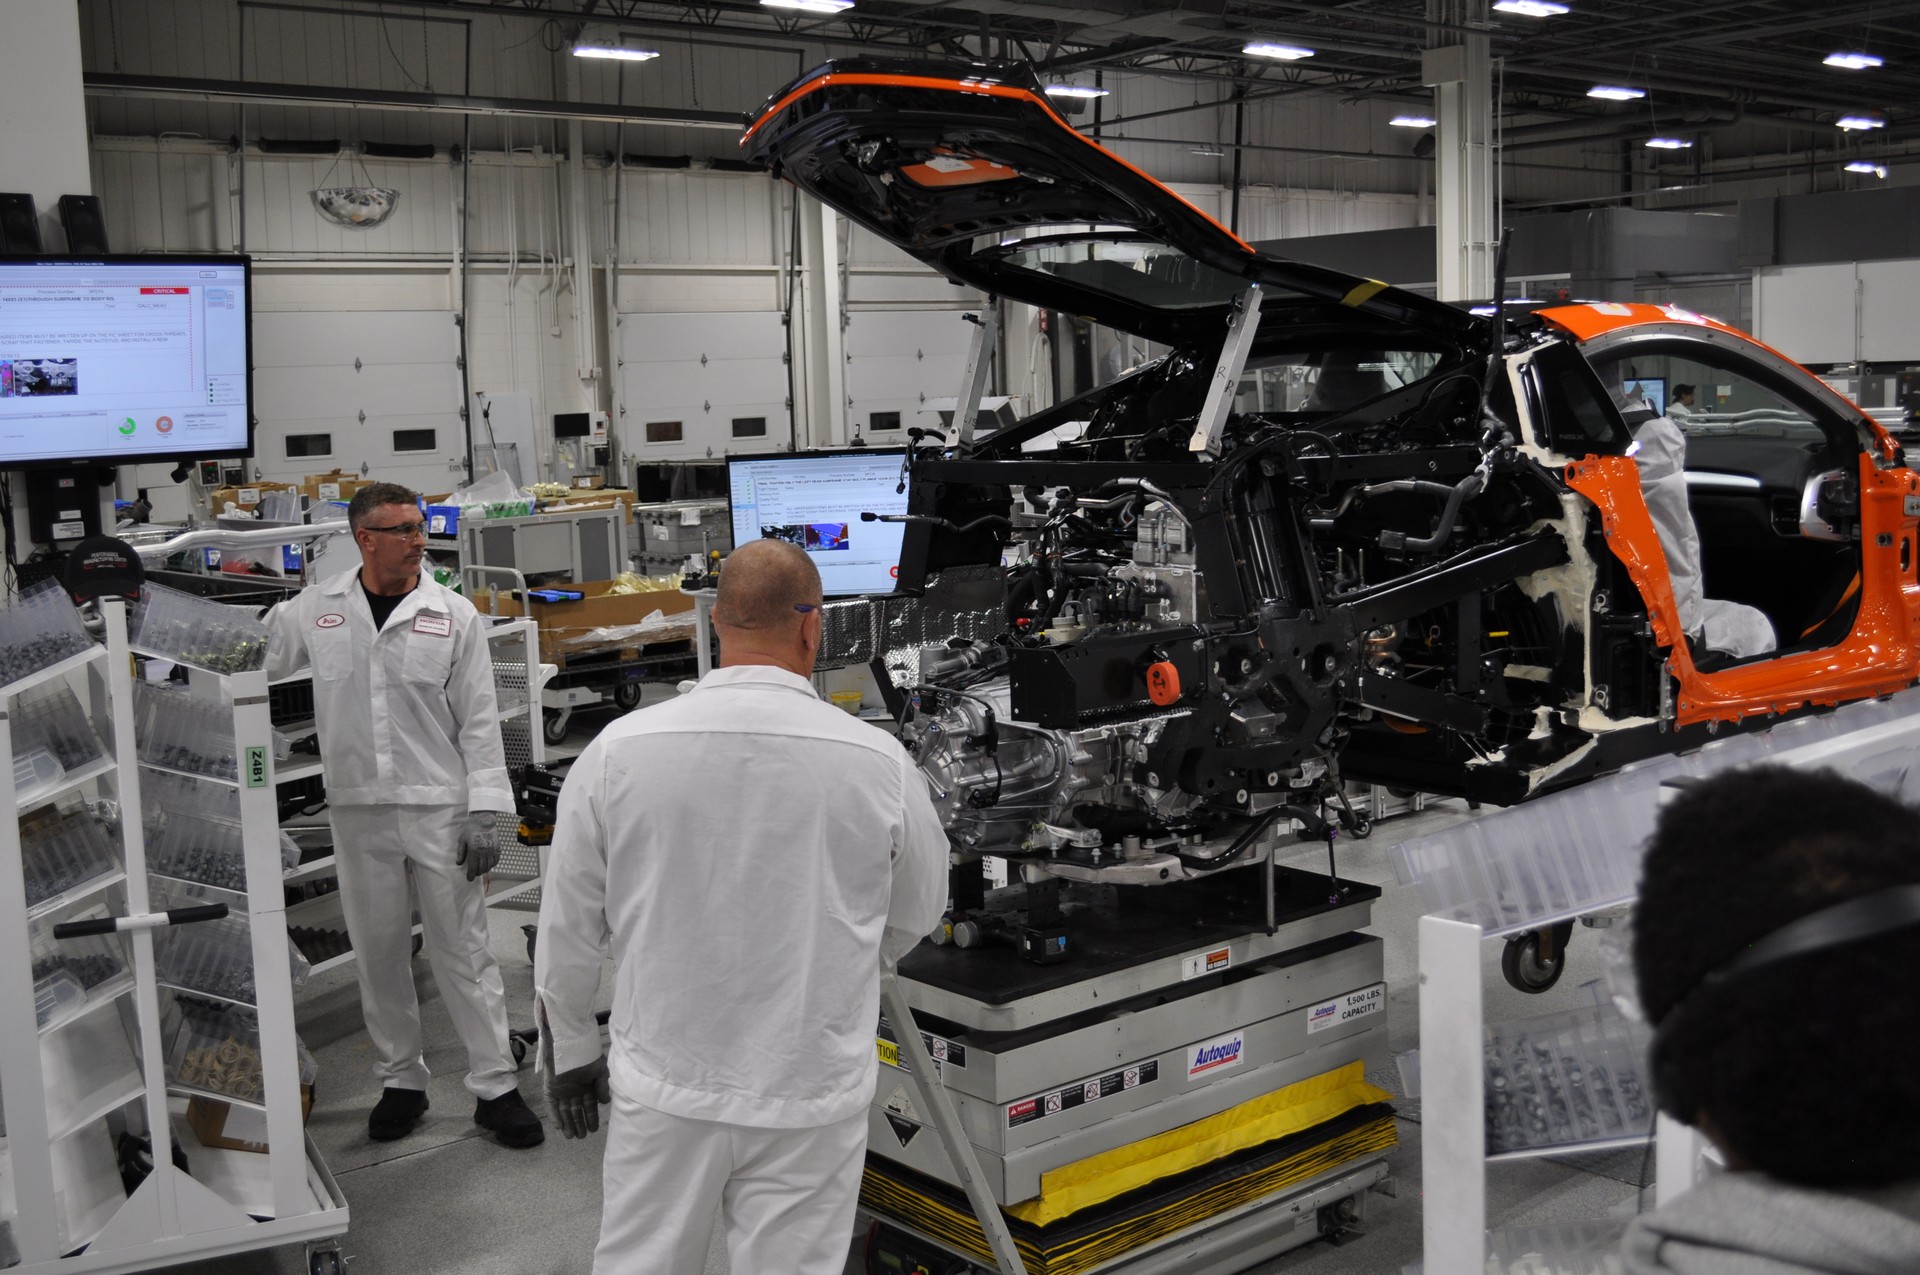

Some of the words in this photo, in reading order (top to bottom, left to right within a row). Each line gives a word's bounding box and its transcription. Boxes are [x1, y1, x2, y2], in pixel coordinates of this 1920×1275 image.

[1216, 366, 1226, 379] R
[1224, 380, 1234, 397] R
[420, 618, 446, 626] HONDA
[251, 750, 263, 783] Z4B1
[1366, 989, 1382, 1000] LBS.
[1314, 1003, 1336, 1017] Autoquip
[1341, 1001, 1377, 1020] CAPACITY
[877, 1043, 897, 1062] TION
[1194, 1037, 1241, 1067] Autoquip
[1017, 1101, 1035, 1112] DANGER
